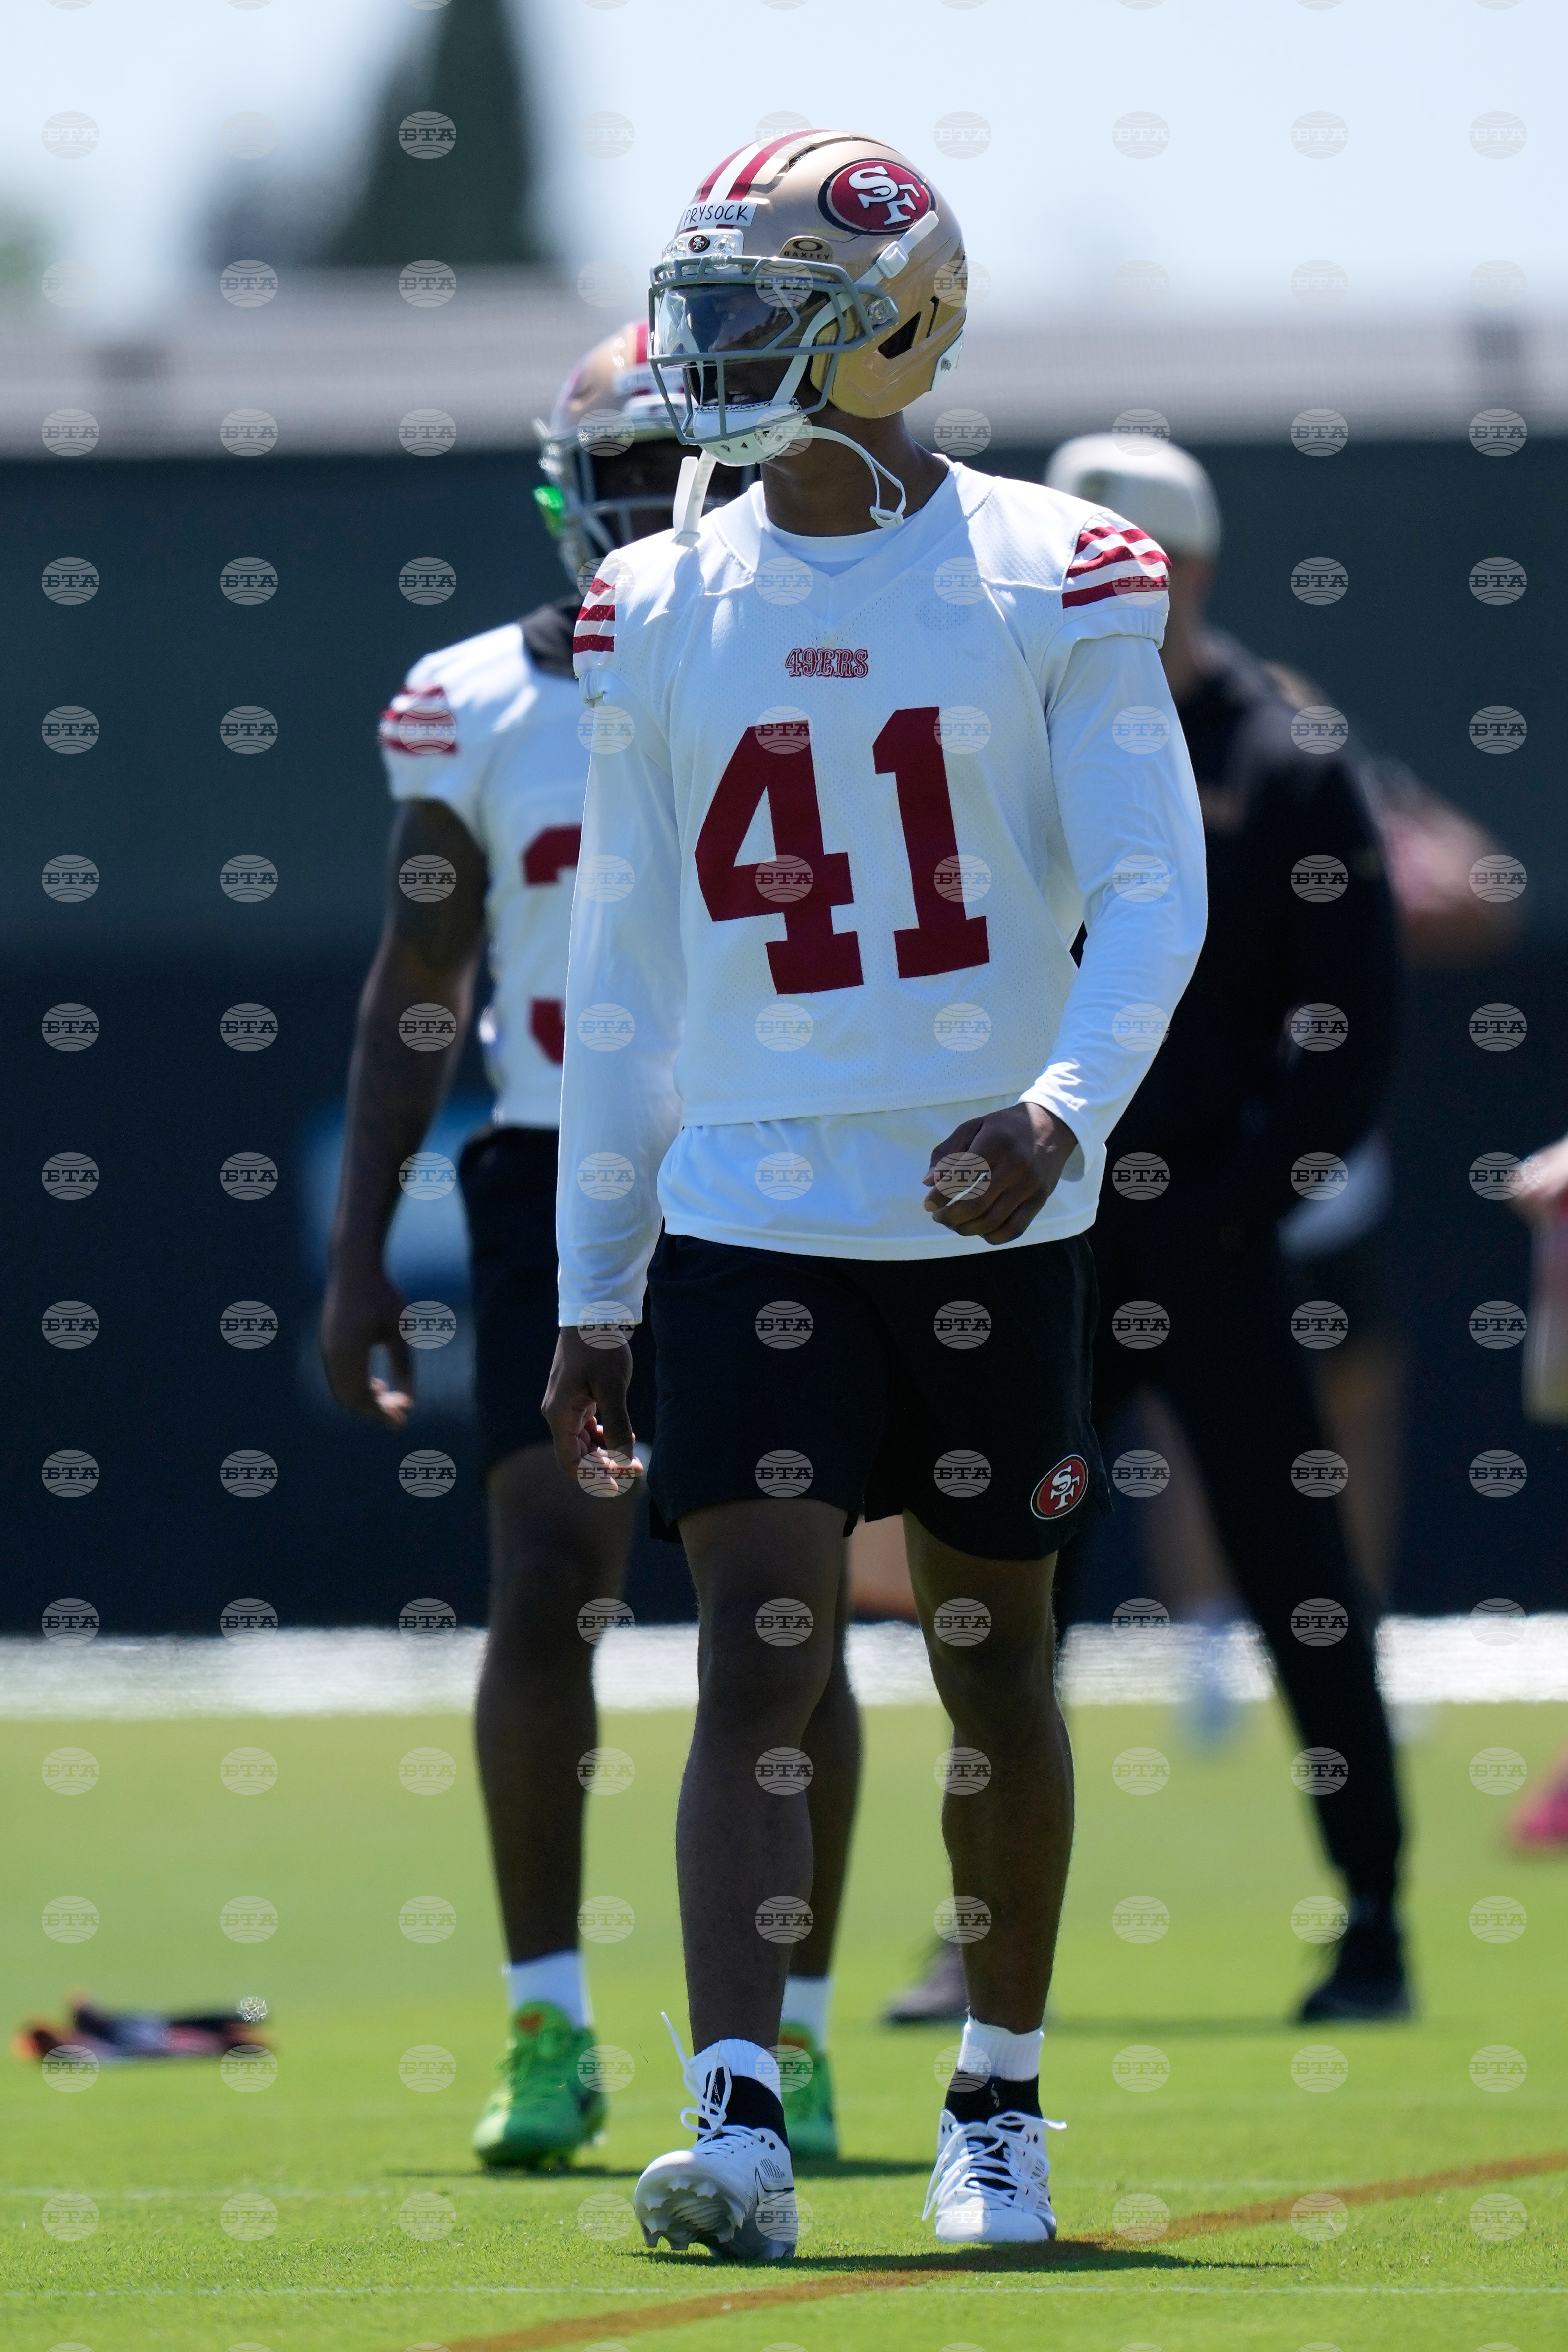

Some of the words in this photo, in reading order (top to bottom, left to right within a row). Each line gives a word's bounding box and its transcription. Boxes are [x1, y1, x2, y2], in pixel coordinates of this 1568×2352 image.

[683, 205, 748, 227] PRYSOCK
[785, 647, 869, 678] 49ERS
[694, 706, 990, 995] 41
